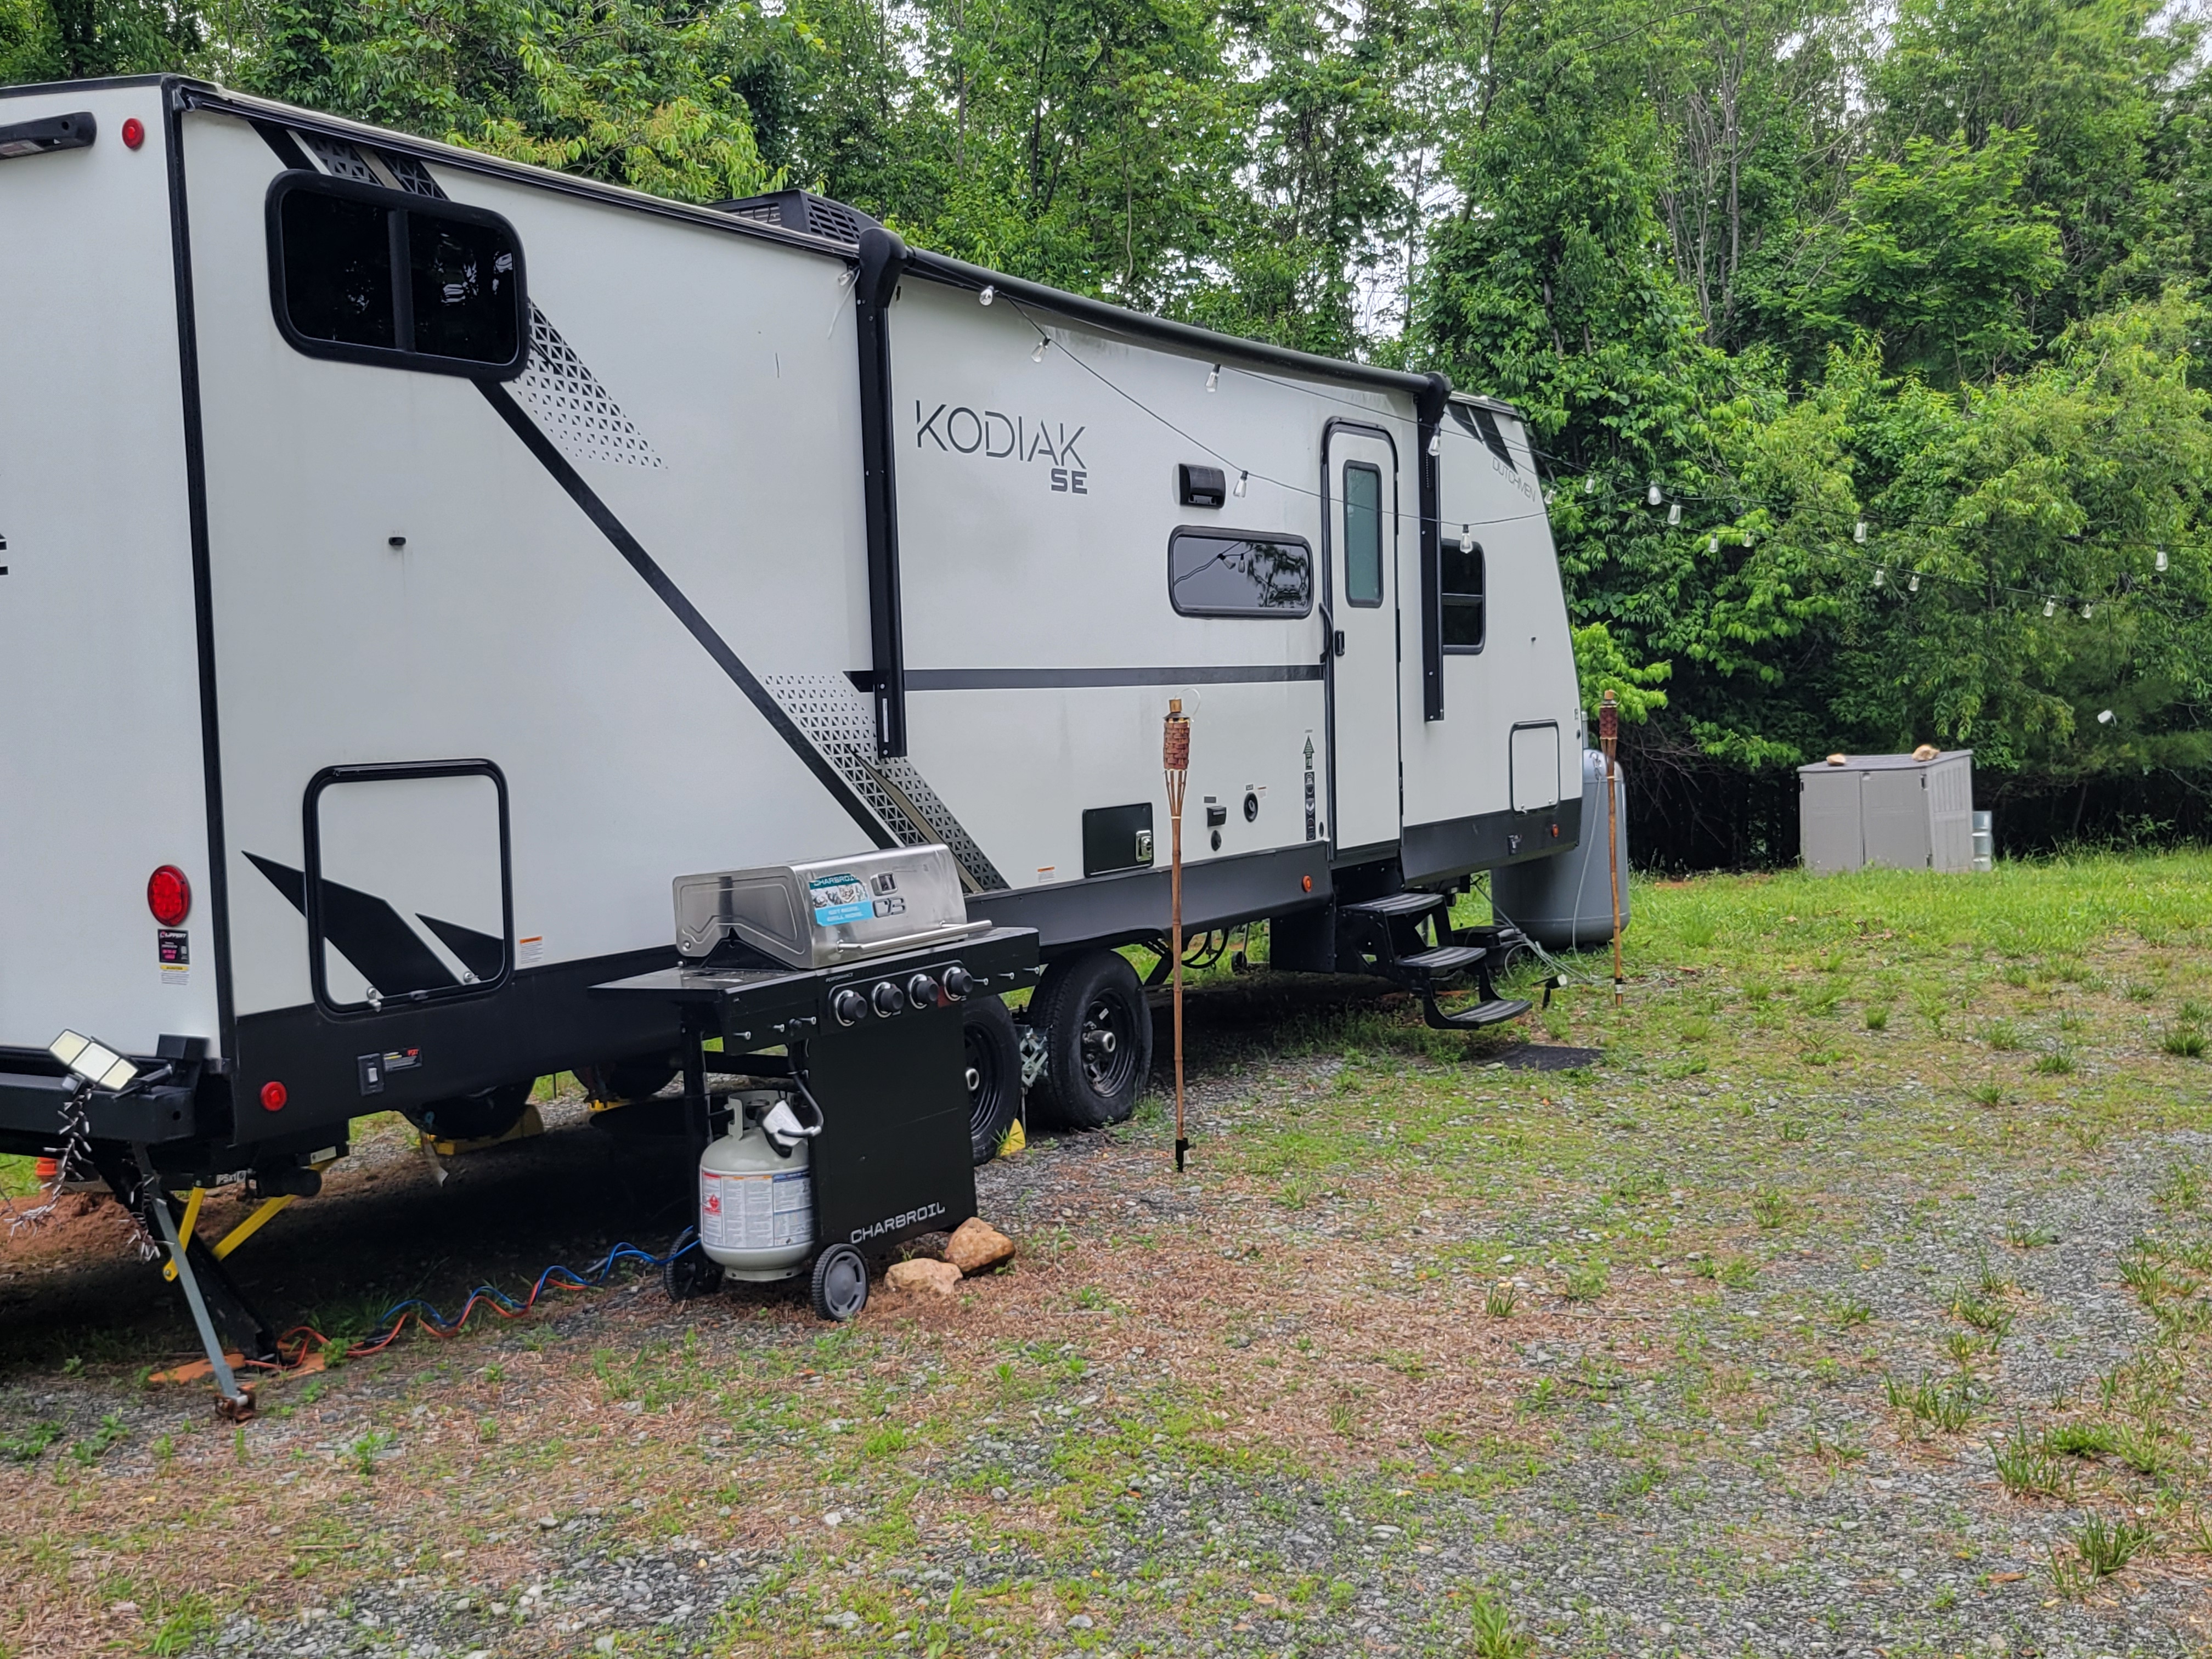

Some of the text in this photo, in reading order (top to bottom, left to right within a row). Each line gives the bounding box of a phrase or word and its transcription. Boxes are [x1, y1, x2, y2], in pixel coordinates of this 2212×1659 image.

[916, 399, 1087, 470] KODIAK
[1051, 467, 1087, 494] SE
[850, 1201, 945, 1244] CHARBROIL
